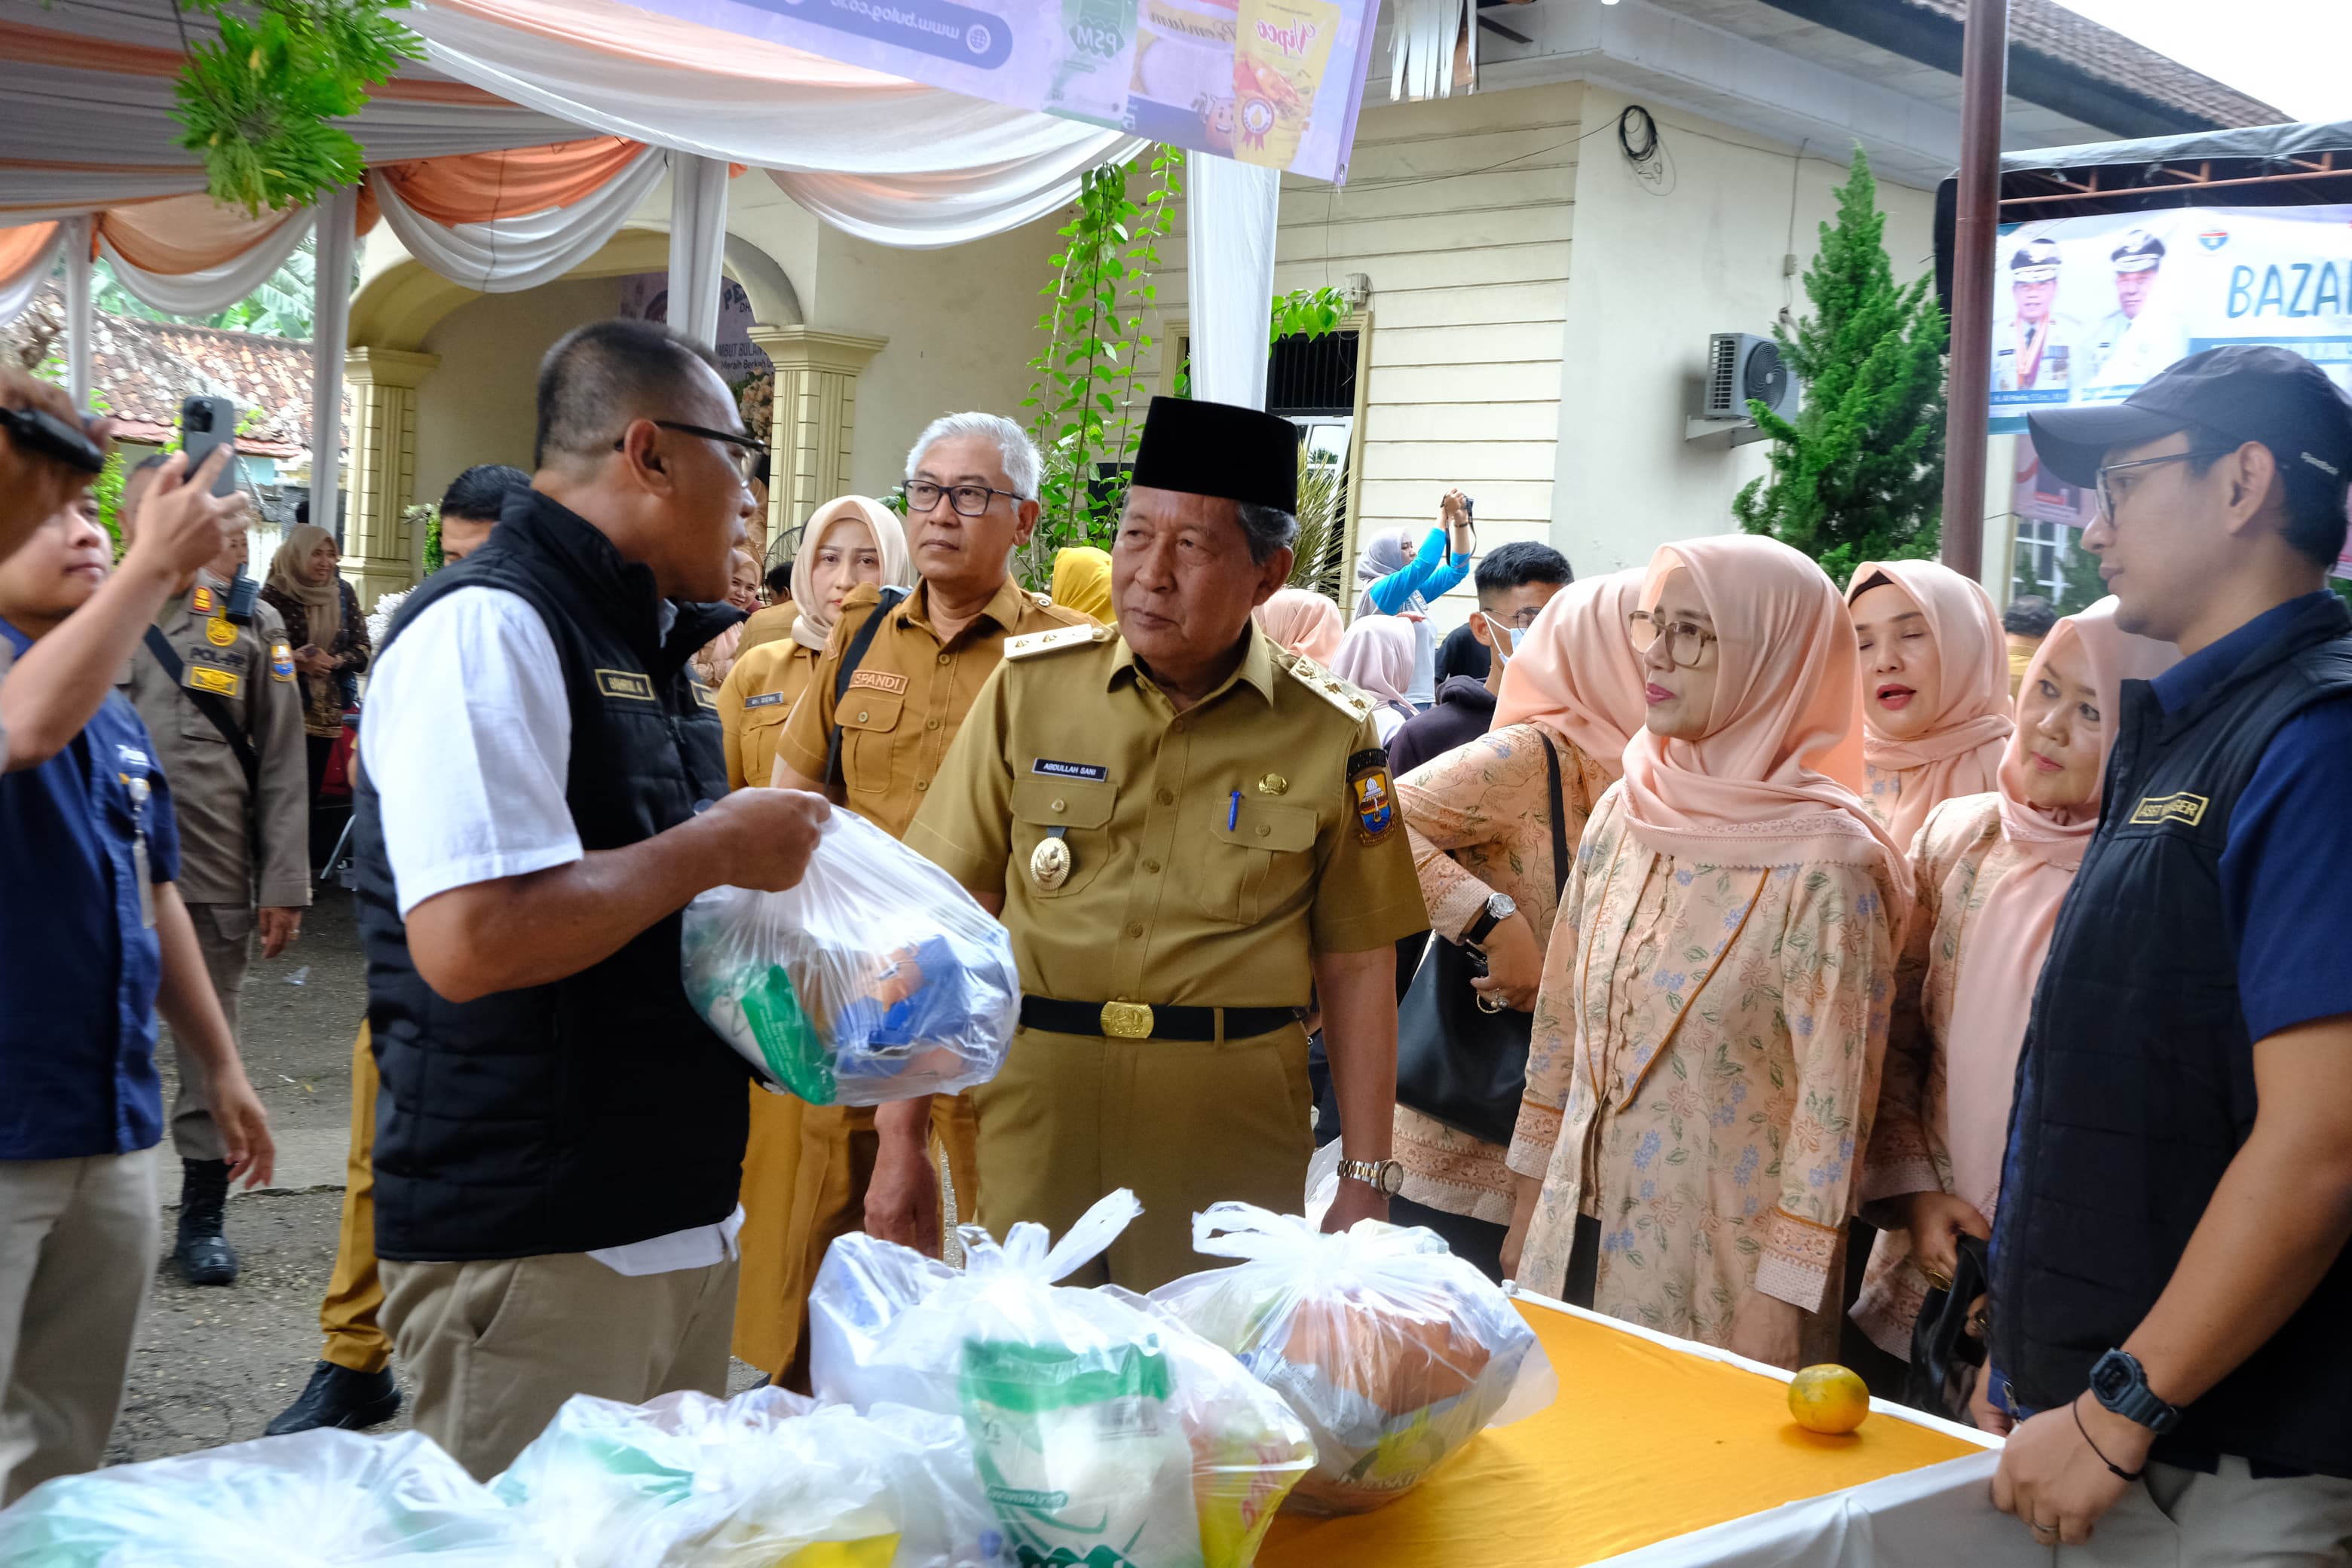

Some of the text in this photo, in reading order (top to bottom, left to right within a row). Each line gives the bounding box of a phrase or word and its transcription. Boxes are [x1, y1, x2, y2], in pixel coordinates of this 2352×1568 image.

[2227, 260, 2352, 318] BAZA
[1043, 763, 1097, 776] ABDULLAH SANI
